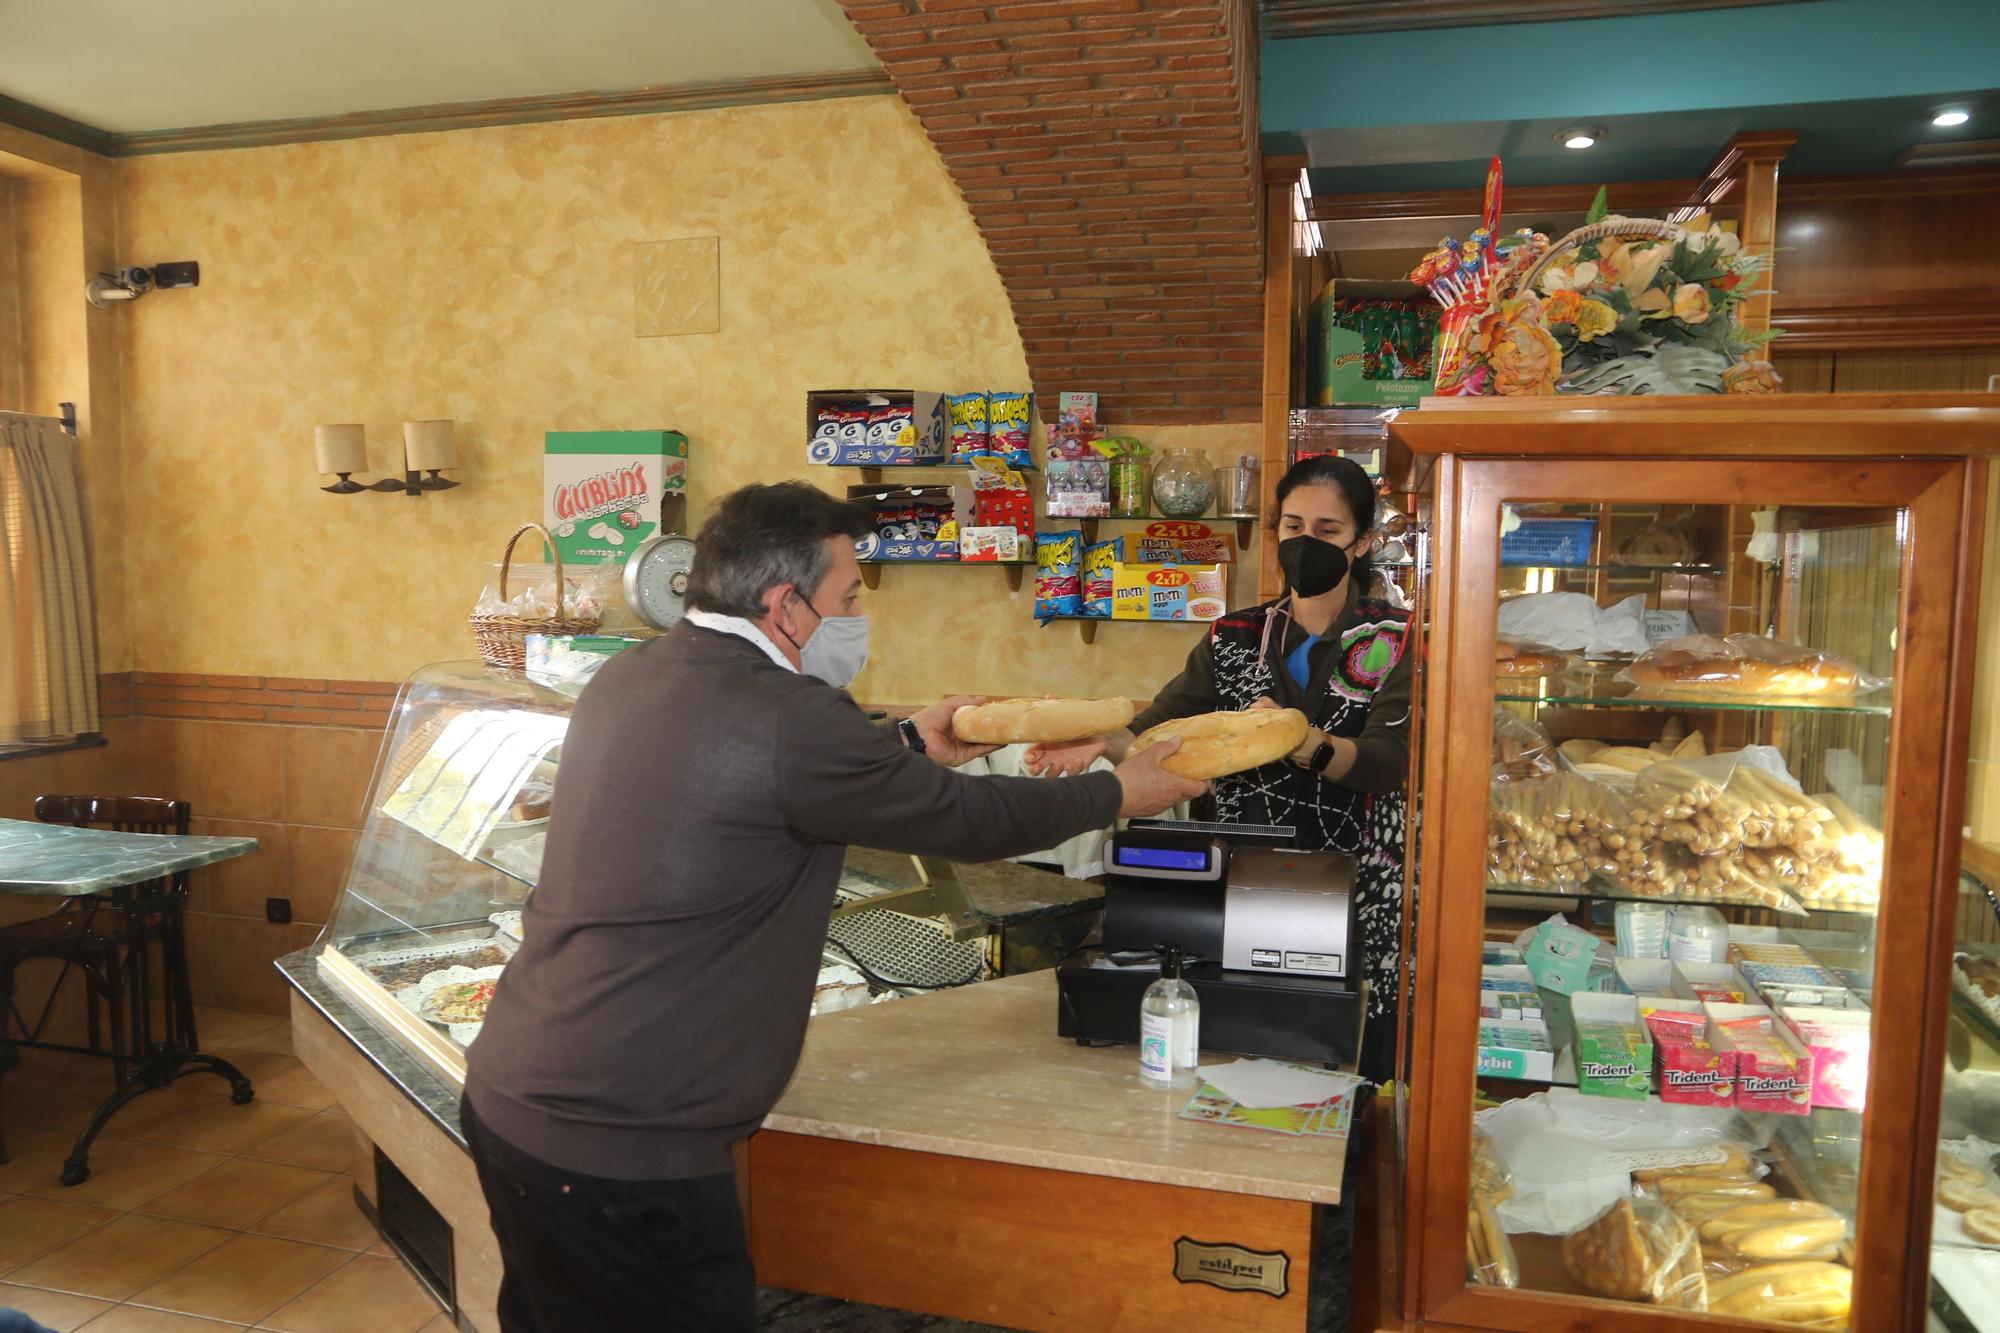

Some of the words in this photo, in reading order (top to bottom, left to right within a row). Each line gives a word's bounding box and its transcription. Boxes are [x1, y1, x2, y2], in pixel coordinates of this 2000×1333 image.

[585, 492, 649, 519] barbacoa
[1586, 1062, 1635, 1076] Trident
[1668, 1071, 1718, 1083] Trident
[1745, 1078, 1795, 1090] Trident
